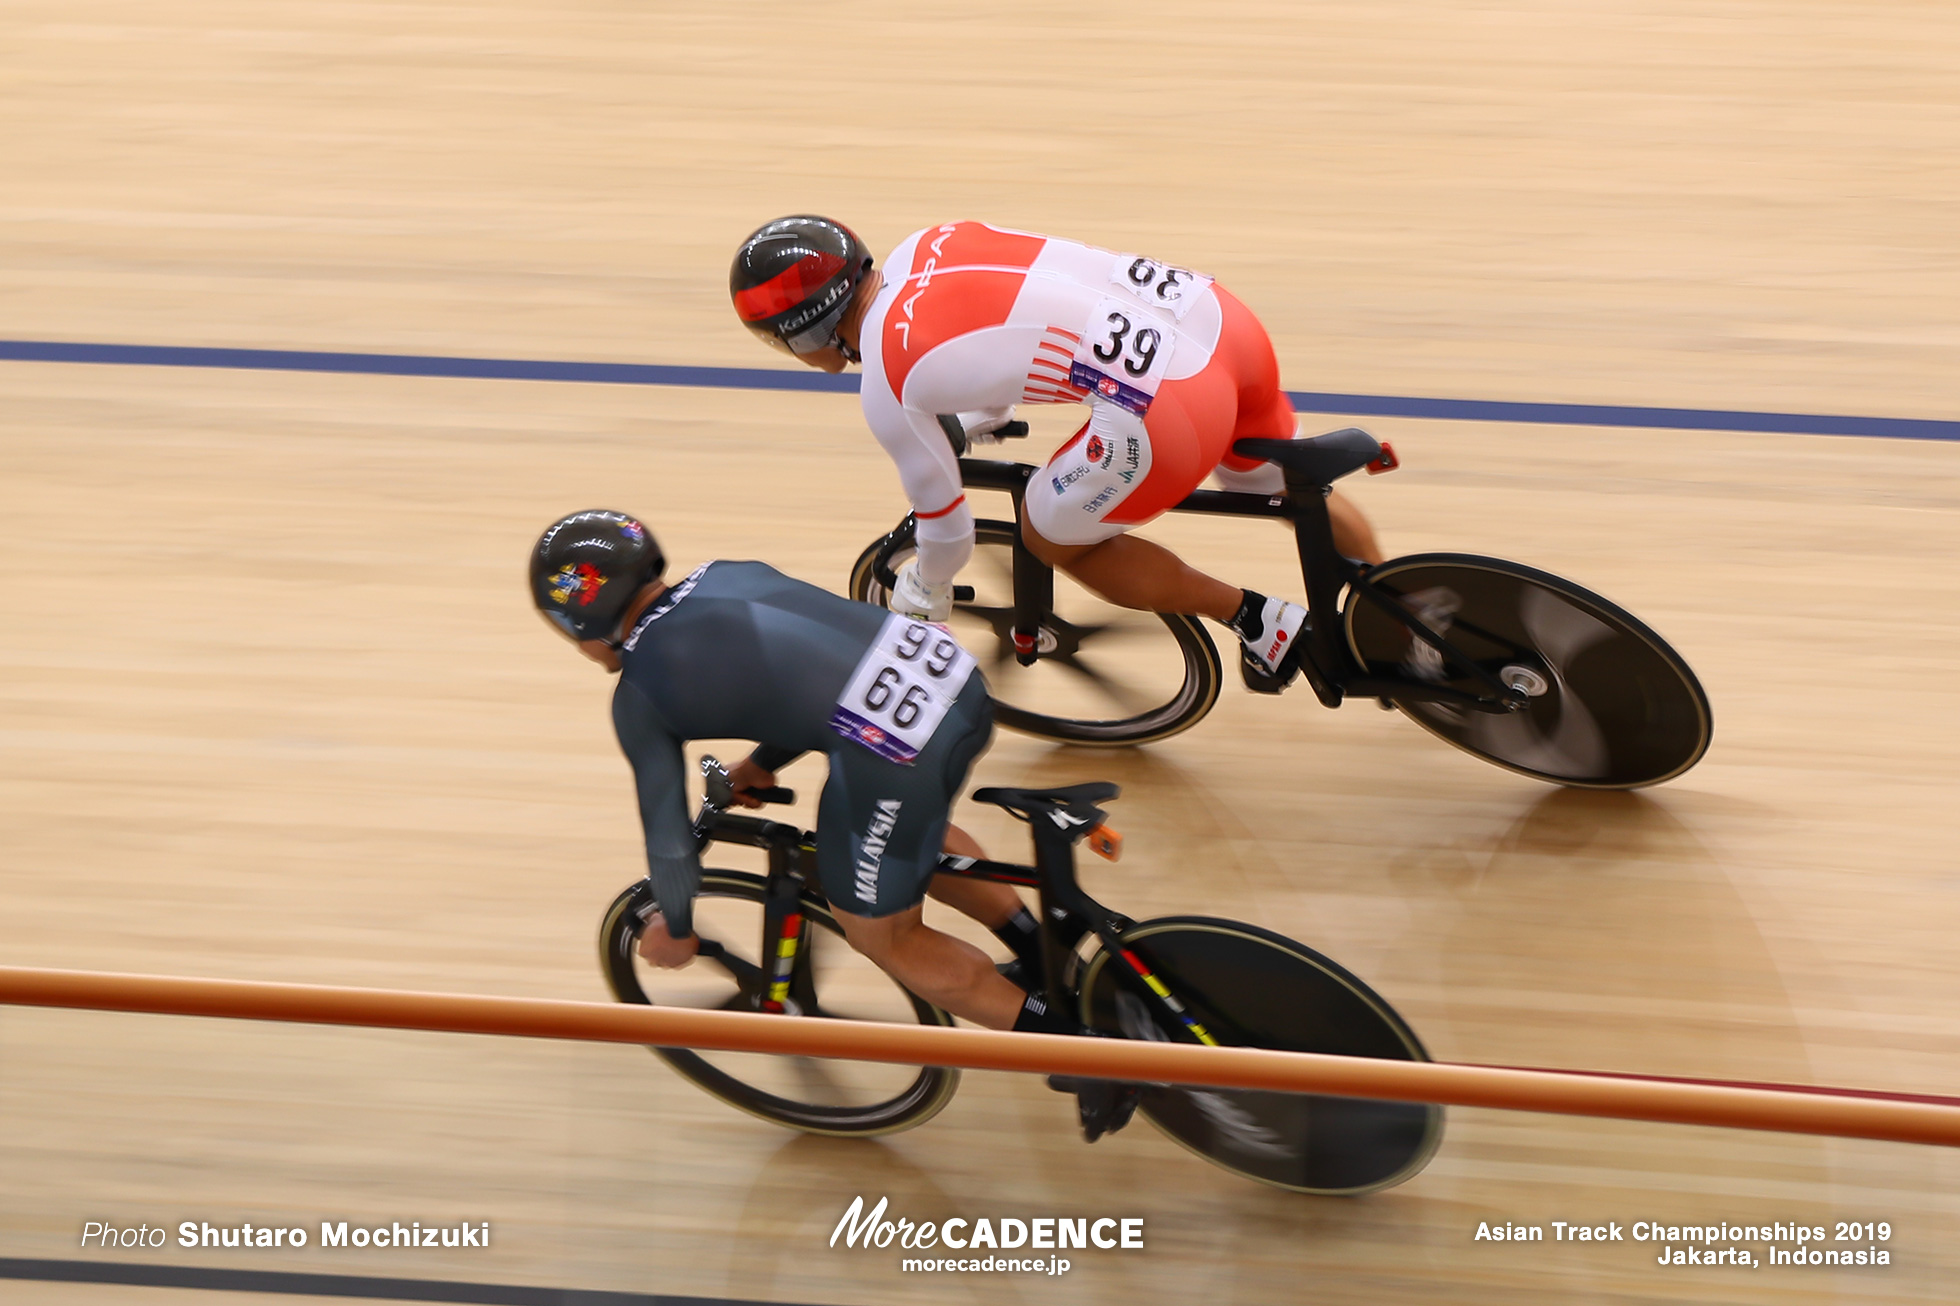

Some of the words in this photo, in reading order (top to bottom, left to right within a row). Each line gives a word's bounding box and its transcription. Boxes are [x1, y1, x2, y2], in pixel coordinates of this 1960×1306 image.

[779, 278, 850, 334] Kabuto
[1092, 311, 1162, 378] 39
[865, 666, 928, 729] 66
[854, 798, 903, 905] MALAYSIA
